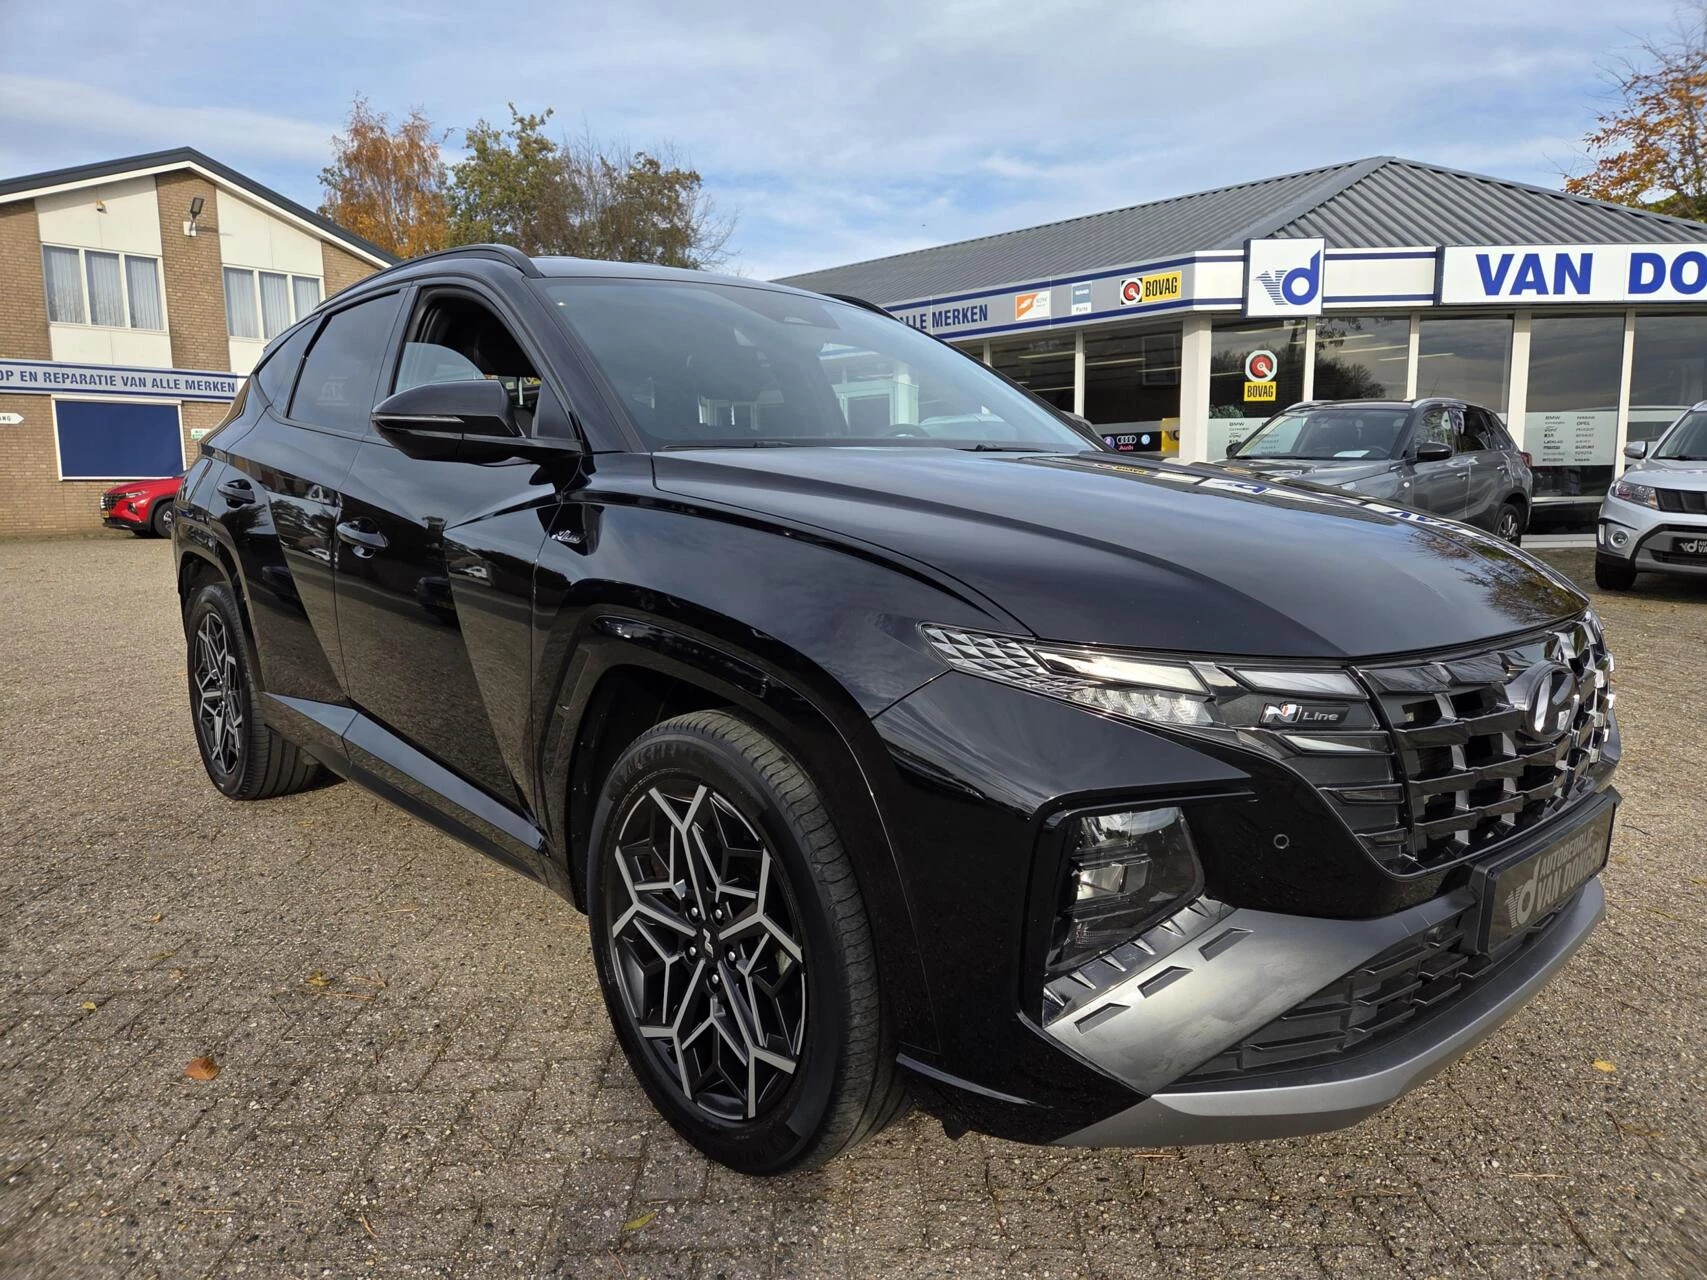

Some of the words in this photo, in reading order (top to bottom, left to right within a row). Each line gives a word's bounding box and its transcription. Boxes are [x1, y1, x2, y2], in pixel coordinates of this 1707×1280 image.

[1475, 252, 1593, 296] VAN
[1145, 276, 1178, 297] BOVAG
[931, 303, 988, 329] MERKEN
[20, 371, 38, 383] EN
[43, 371, 117, 387] REPARATIE
[121, 375, 147, 388] VAN
[151, 377, 181, 389] ALLE
[185, 379, 235, 393] MERKEN
[1246, 385, 1274, 398] BOVAG
[1302, 712, 1339, 721] Line
[1536, 868, 1562, 912] VAN
